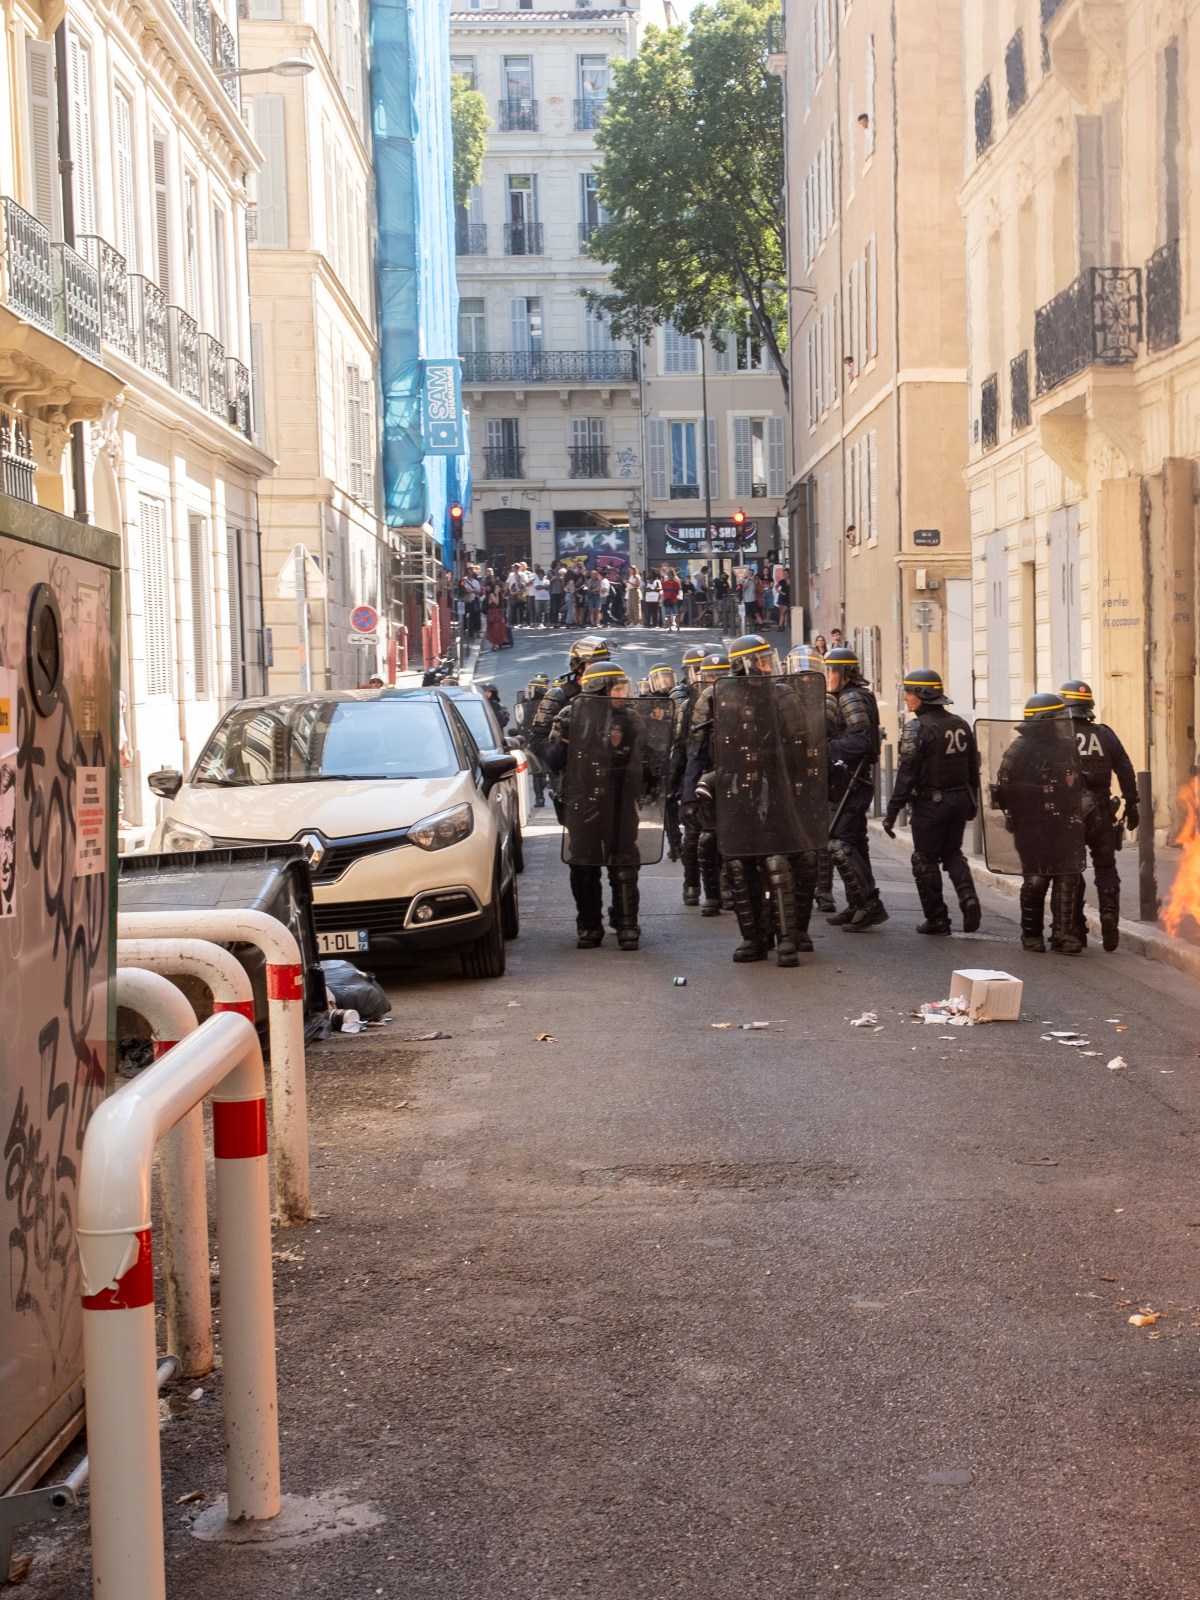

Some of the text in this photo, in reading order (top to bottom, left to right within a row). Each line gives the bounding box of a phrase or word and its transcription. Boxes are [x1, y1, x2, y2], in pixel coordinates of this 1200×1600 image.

[426, 366, 449, 419] SAM
[678, 527, 737, 539] NIGHT SHO
[945, 728, 967, 754] 2C
[1076, 733, 1104, 756] 2A
